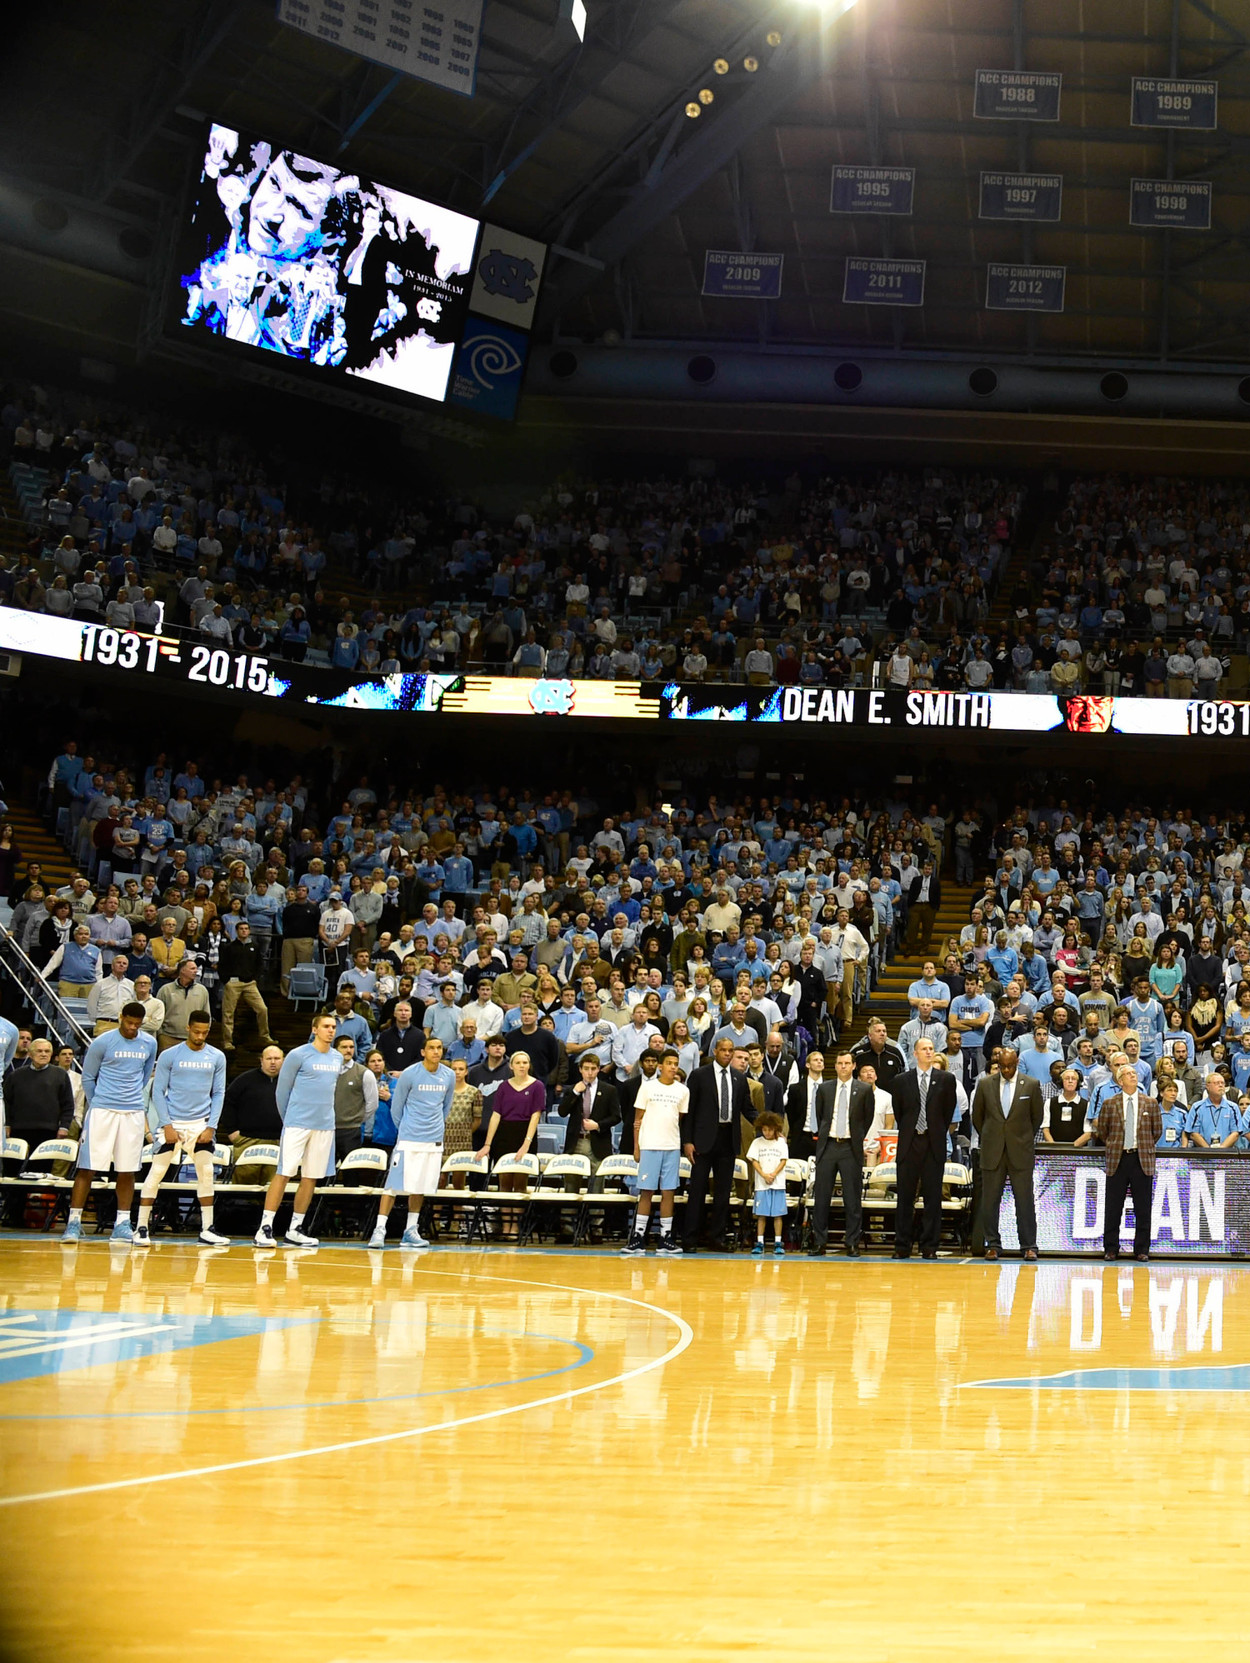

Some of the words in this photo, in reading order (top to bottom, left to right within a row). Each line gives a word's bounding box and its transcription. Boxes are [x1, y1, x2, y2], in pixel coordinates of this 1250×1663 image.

[979, 74, 1000, 84] ACC
[1002, 75, 1058, 86] CHAMPIONS
[1136, 82, 1155, 91] ACC
[1157, 83, 1214, 94] CHAMPIONS
[1000, 88, 1035, 102] 1988
[1156, 95, 1191, 110] 1989
[836, 169, 855, 179] ACC
[856, 170, 911, 181] CHAMPIONS
[984, 175, 1003, 185] ACC
[1005, 176, 1059, 188] CHAMPIONS
[856, 183, 889, 196] 1995
[1134, 182, 1153, 192] ACC
[1155, 183, 1208, 195] CHAMPIONS
[1005, 189, 1037, 202] 1997
[1154, 196, 1187, 210] 1998
[709, 254, 727, 264] ACC
[729, 256, 779, 266] CHAMPIONS
[850, 261, 868, 270] ACC
[870, 262, 922, 273] CHAMPIONS
[991, 267, 1010, 276] ACC
[1011, 268, 1062, 279] CHAMPIONS
[726, 267, 760, 280] 2009
[404, 269, 415, 278] IN
[416, 272, 463, 295] MEMORIAM
[869, 275, 902, 287] 2011
[1009, 280, 1042, 294] 2012
[82, 626, 159, 673] 1931
[188, 646, 270, 694] 2015
[784, 689, 854, 724] DEAN
[868, 692, 891, 724] E.
[906, 692, 990, 728] SMITH
[1188, 702, 1250, 736] 1931
[326, 924, 338, 932] 40
[1137, 1024, 1149, 1034] 23
[418, 1084, 446, 1092] CAROLINA
[38, 1144, 71, 1154] CAROLINA
[244, 1149, 279, 1158] CAROLINA
[348, 1154, 381, 1164] CAROLINA
[552, 1159, 585, 1168] CAROLINA
[603, 1159, 638, 1168] CAROLIN
[1073, 1167, 1226, 1240] DAN
